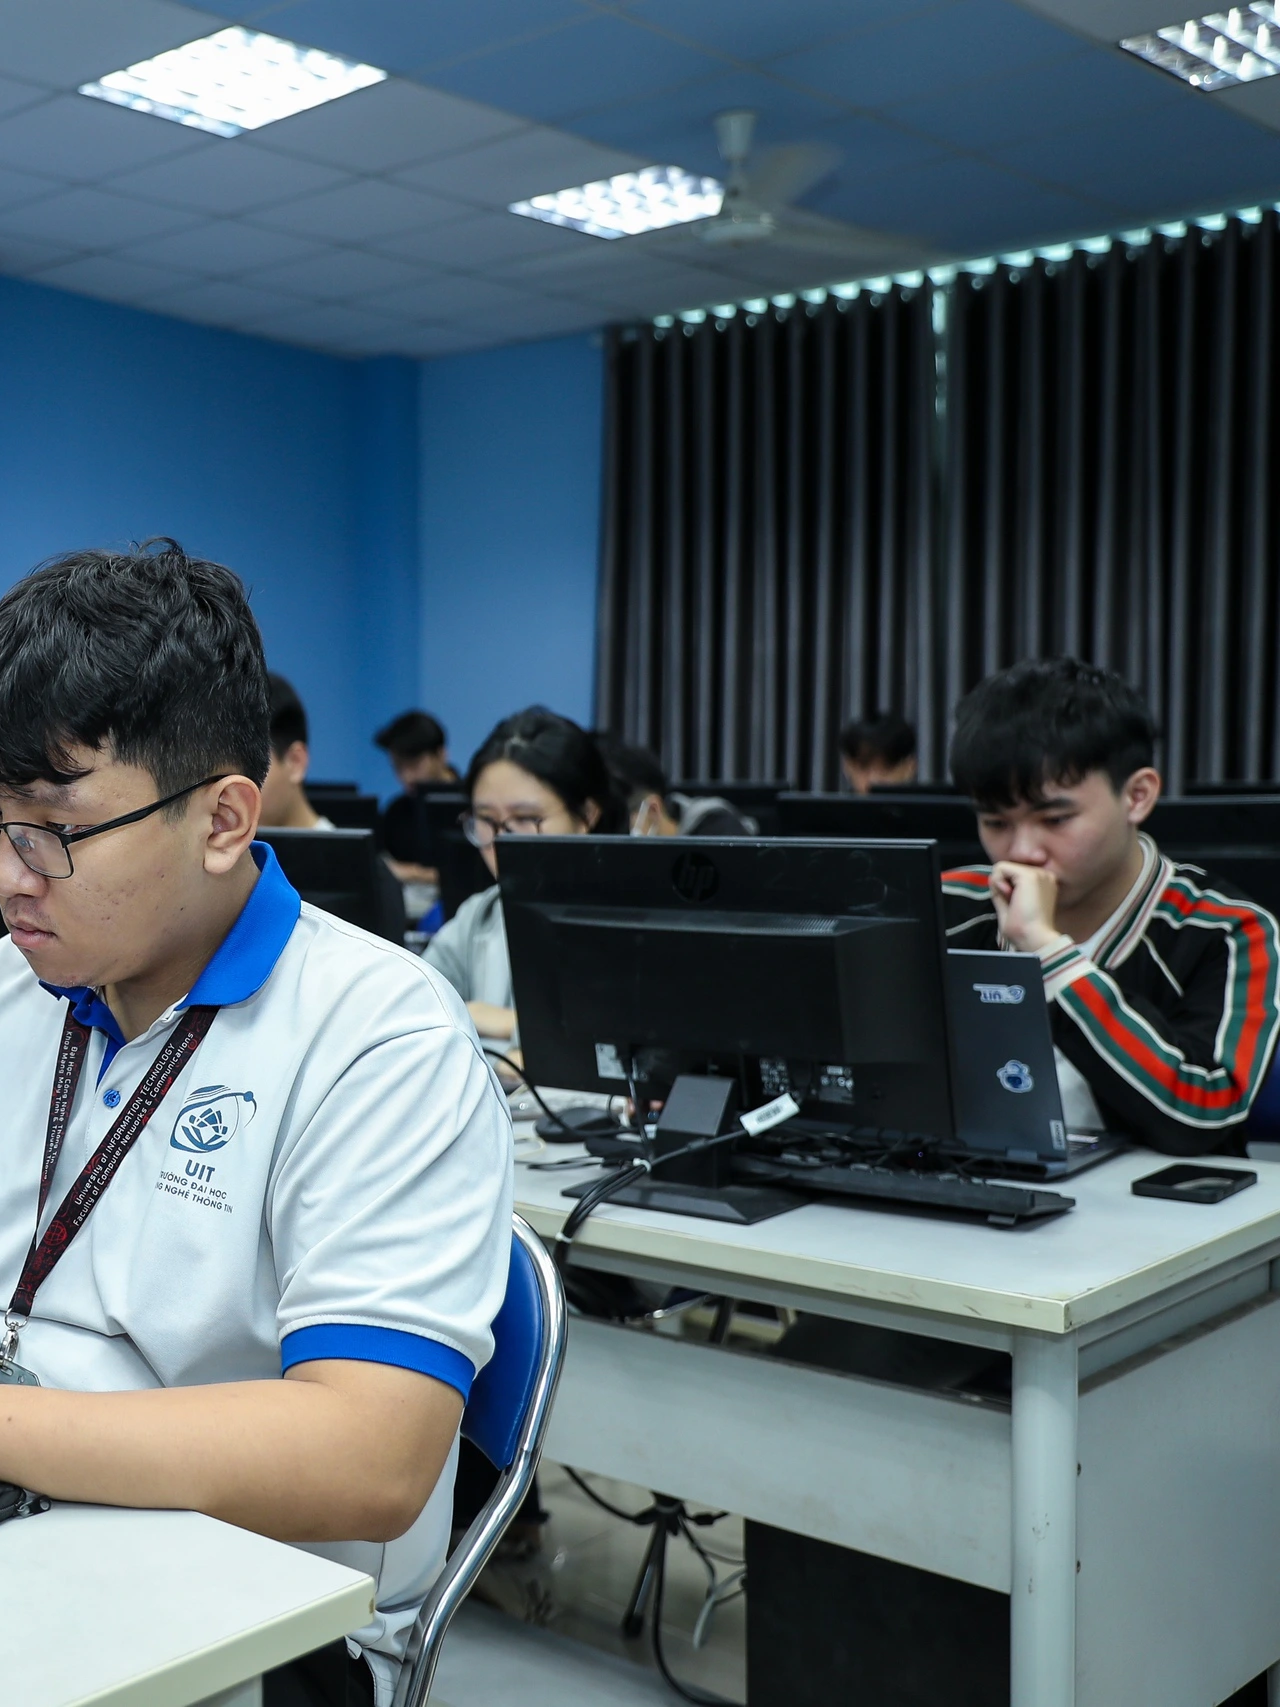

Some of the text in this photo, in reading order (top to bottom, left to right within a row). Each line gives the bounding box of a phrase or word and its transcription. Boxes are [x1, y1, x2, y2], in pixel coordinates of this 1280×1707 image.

[73, 1197, 95, 1227] Faculty
[92, 1185, 100, 1196] of
[97, 1147, 123, 1187] Computer
[120, 1107, 148, 1147] Networks
[149, 1032, 195, 1098] Communications
[74, 1043, 176, 1206] University of INFORMATION TECHNOLOGY
[185, 1159, 216, 1183] UIT
[164, 1184, 190, 1201] NGHỆ
[192, 1193, 223, 1210] THÔNG
[190, 1181, 208, 1194] ĐẠI
[209, 1188, 227, 1200] HỌC
